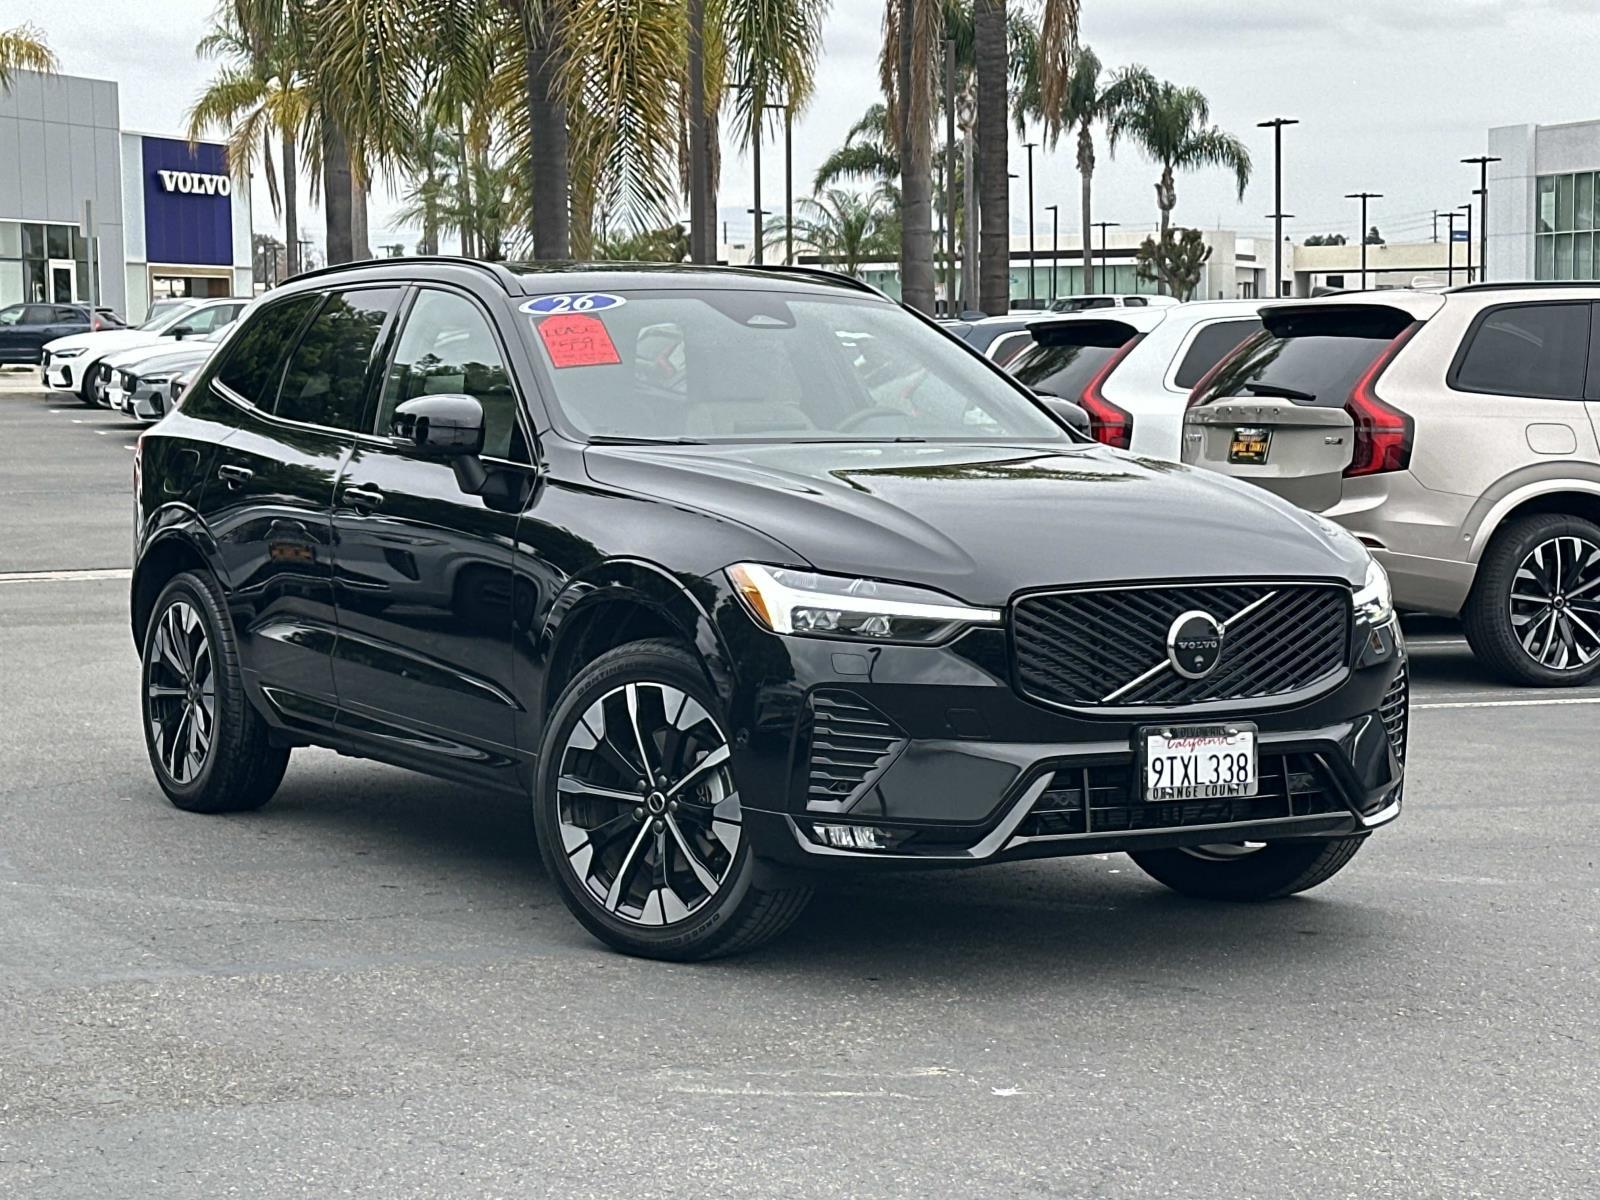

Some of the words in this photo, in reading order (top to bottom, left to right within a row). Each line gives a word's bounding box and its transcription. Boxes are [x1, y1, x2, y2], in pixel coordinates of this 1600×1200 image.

[157, 169, 231, 197] VOLVO
[551, 294, 596, 313] 26
[1214, 406, 1281, 415] VOLVO
[1178, 640, 1218, 650] VOLVO
[1167, 736, 1236, 752] California
[1151, 752, 1249, 788] 9TXL338
[1152, 784, 1198, 800] ORANGE
[1204, 783, 1249, 797] COUNTY
